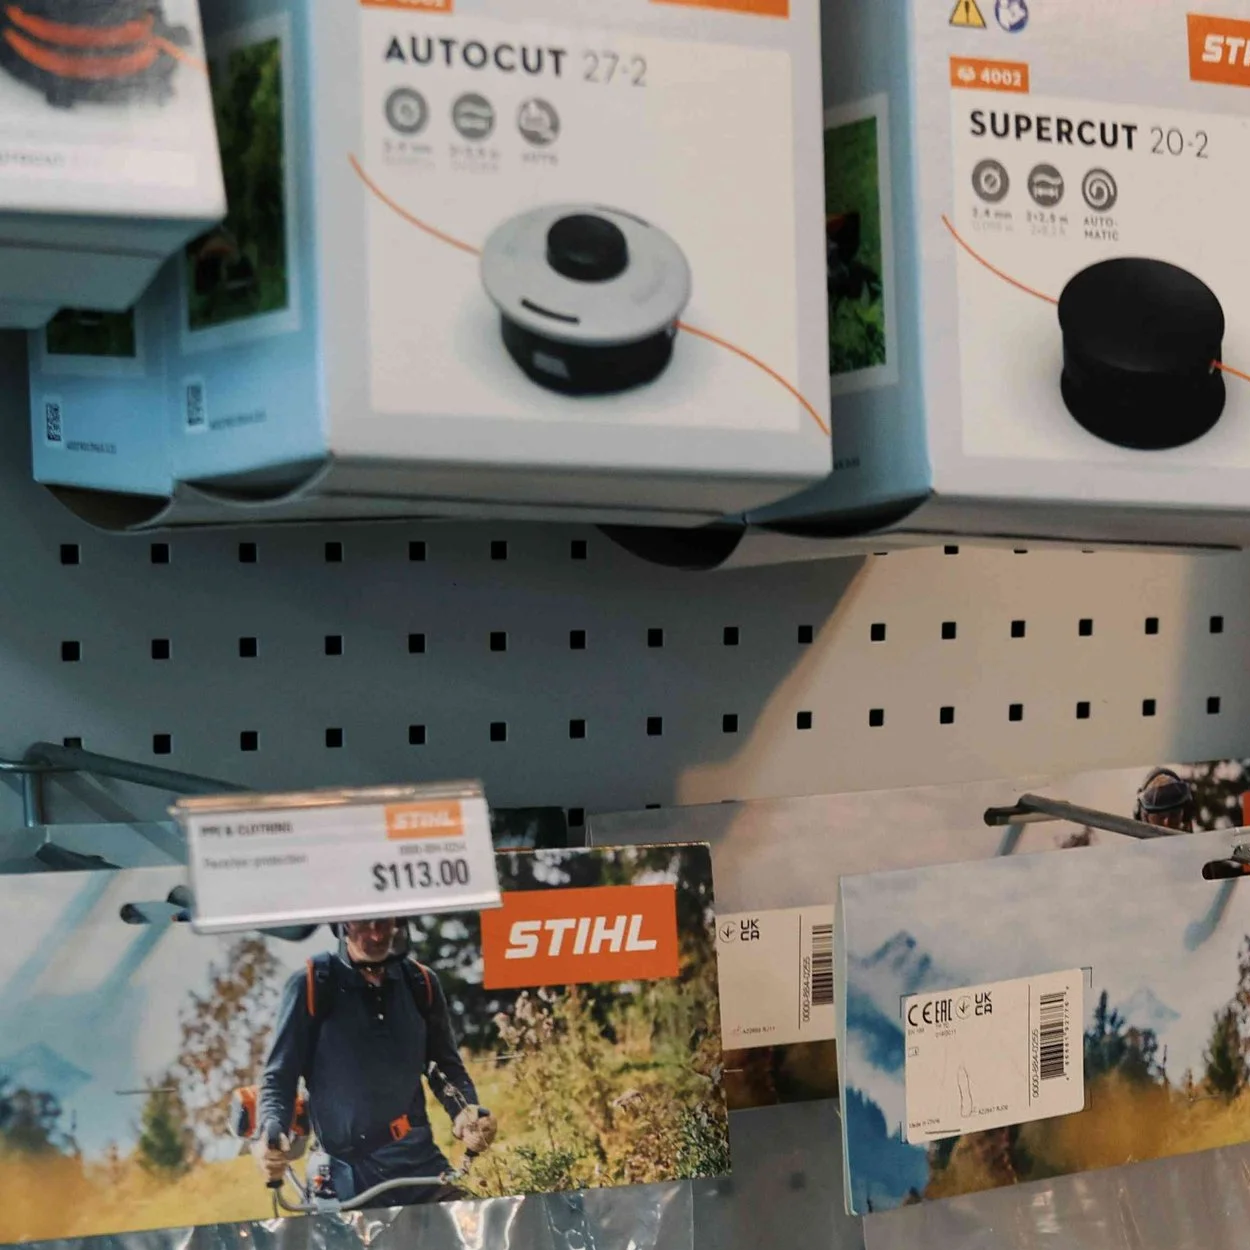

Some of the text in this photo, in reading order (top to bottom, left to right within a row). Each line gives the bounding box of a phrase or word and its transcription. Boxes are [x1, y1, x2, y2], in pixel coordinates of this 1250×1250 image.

[384, 35, 568, 77] AUTOCUT
[980, 67, 1022, 88] 4002
[969, 110, 1210, 159] SUPERCUT 20-2
[1084, 230, 1119, 241] MATIC
[393, 810, 456, 831] STIHL
[372, 858, 470, 892] $113.00
[740, 918, 760, 930] UK
[504, 913, 658, 960] STIHL
[740, 930, 760, 941] CA
[974, 991, 993, 1004] UK
[974, 1003, 993, 1016] CA
